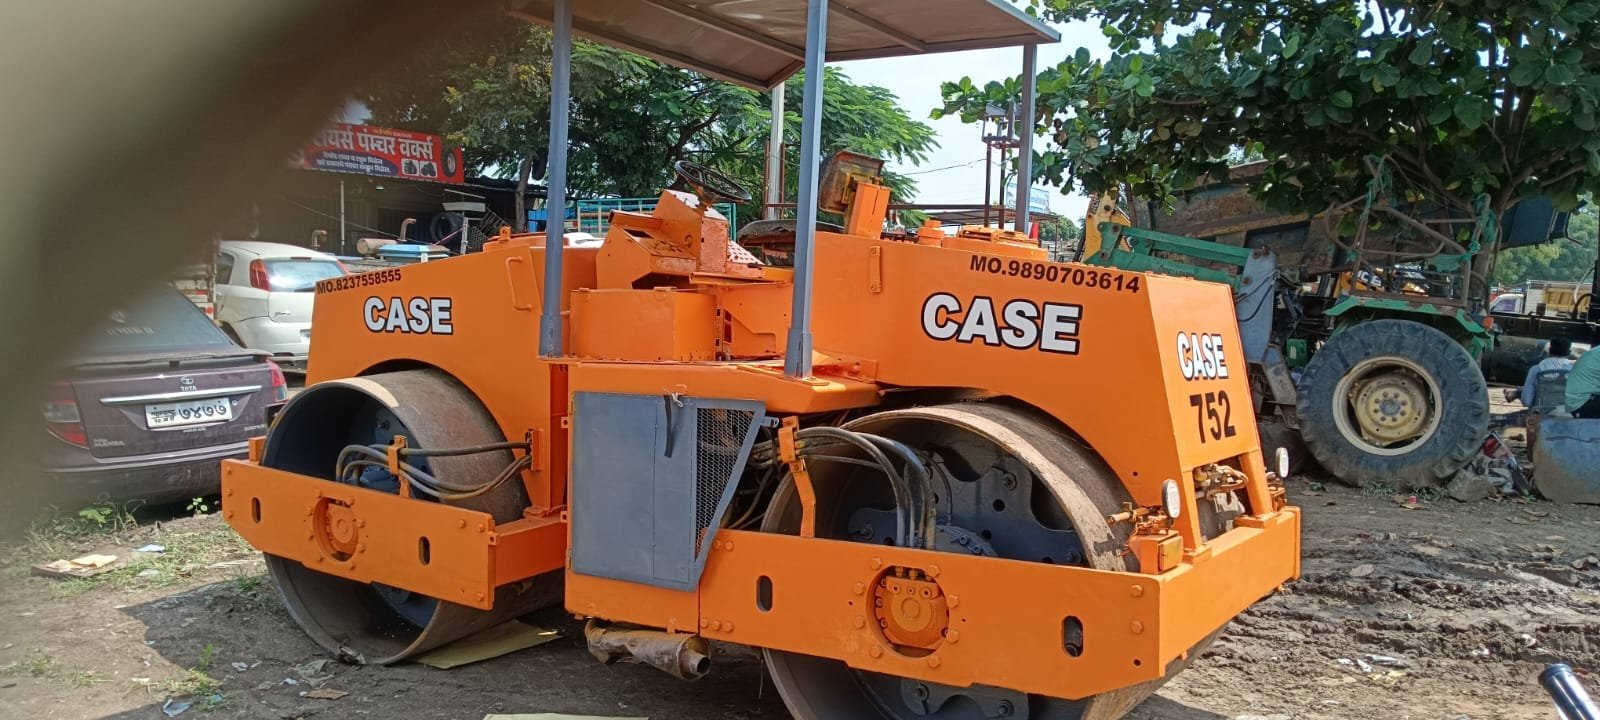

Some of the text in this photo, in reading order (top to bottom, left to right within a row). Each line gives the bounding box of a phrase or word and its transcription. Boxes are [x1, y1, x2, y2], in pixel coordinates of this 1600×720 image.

[398, 135, 433, 160] वर्क्स
[316, 269, 402, 295] MO.8237558555
[970, 255, 1140, 293] MO.9890703614
[363, 296, 453, 335] CASE
[921, 291, 1083, 355] CASE
[1176, 331, 1229, 381] CASE
[1190, 390, 1237, 444] 752
